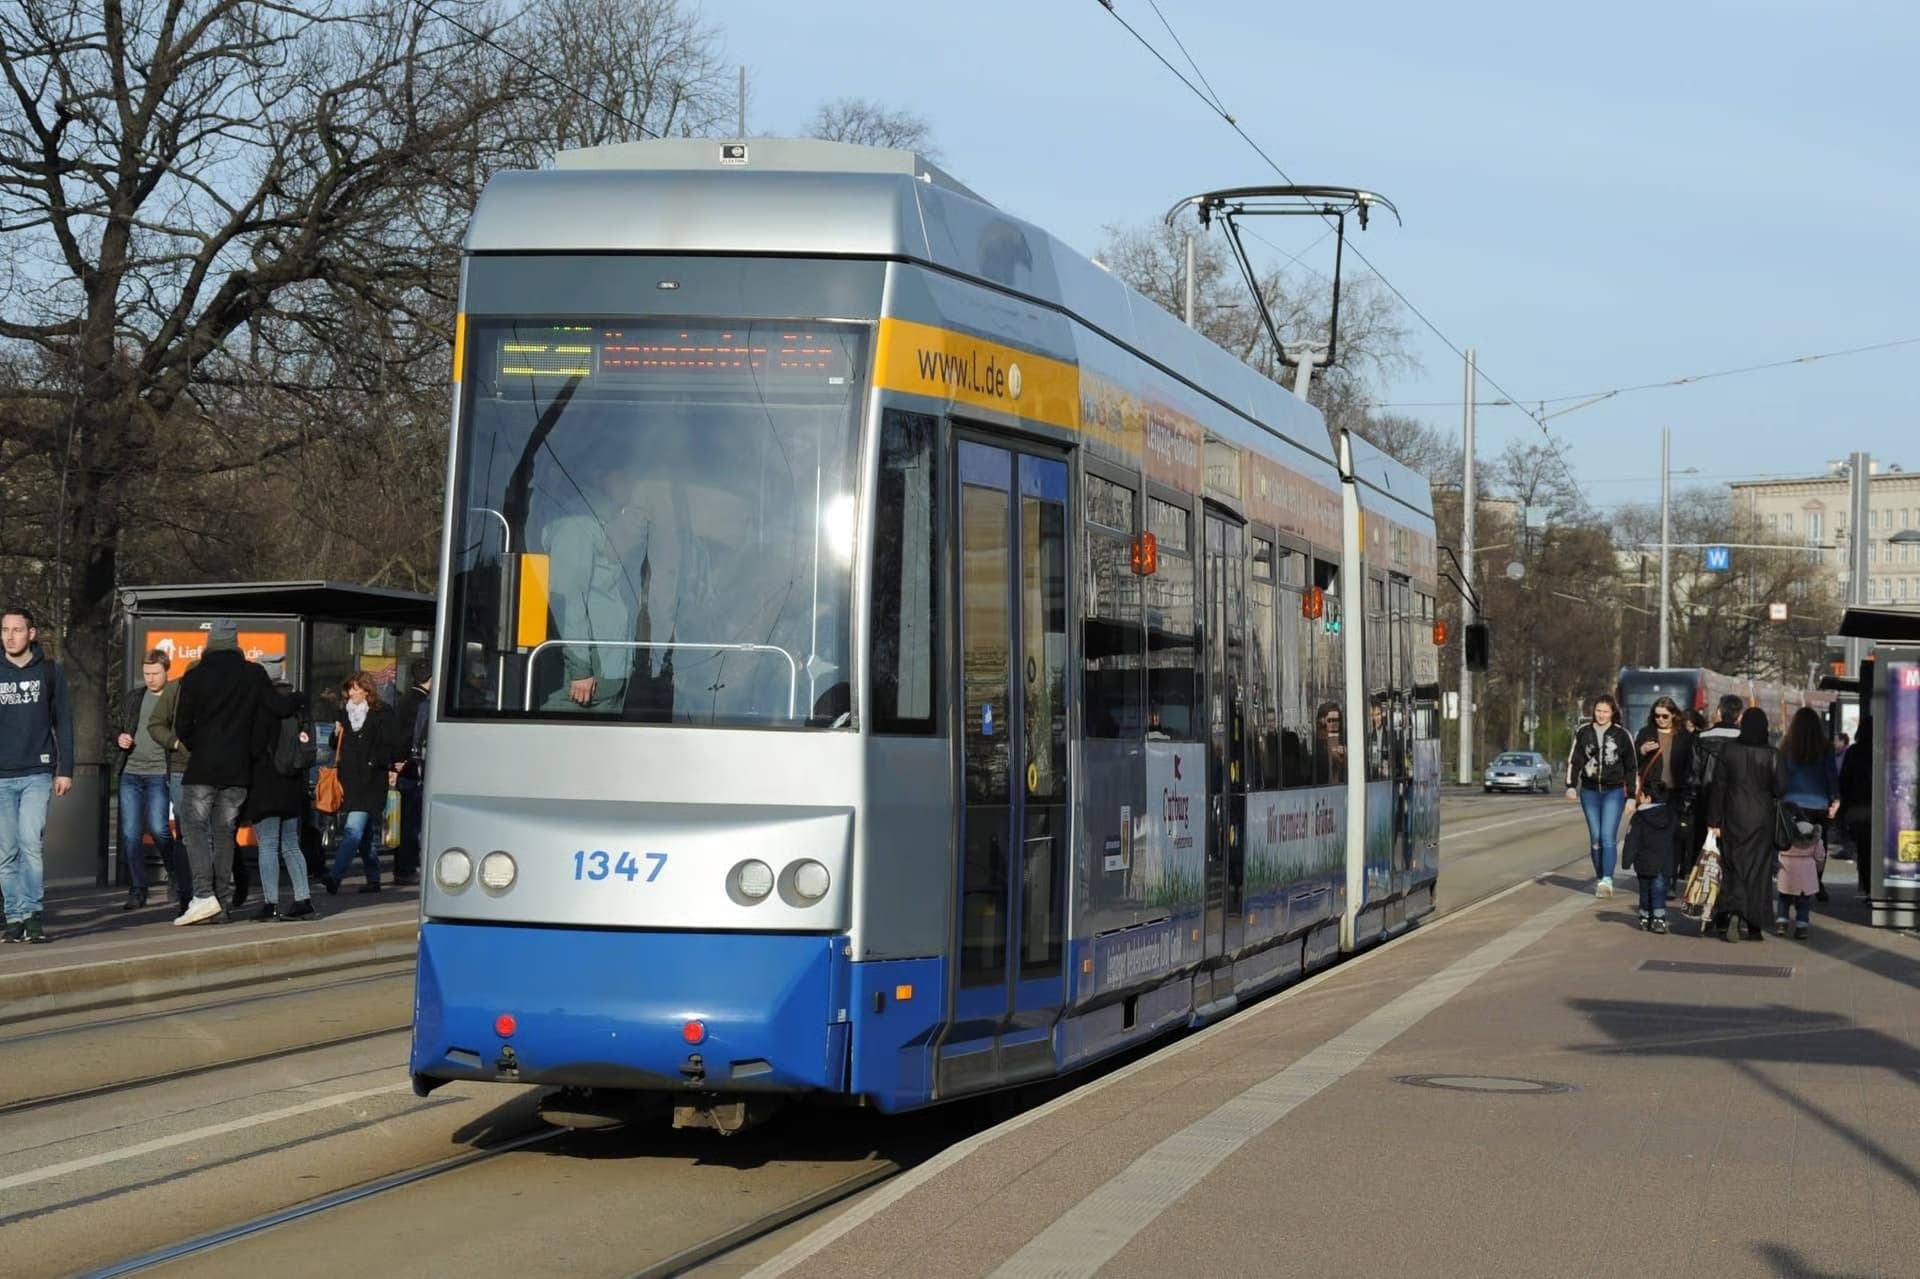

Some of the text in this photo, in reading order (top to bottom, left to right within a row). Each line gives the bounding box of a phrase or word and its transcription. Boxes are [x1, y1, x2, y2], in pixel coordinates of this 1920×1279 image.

[918, 348, 1004, 398] www.L.de
[1709, 549, 1727, 567] W
[574, 850, 668, 882] 1347
